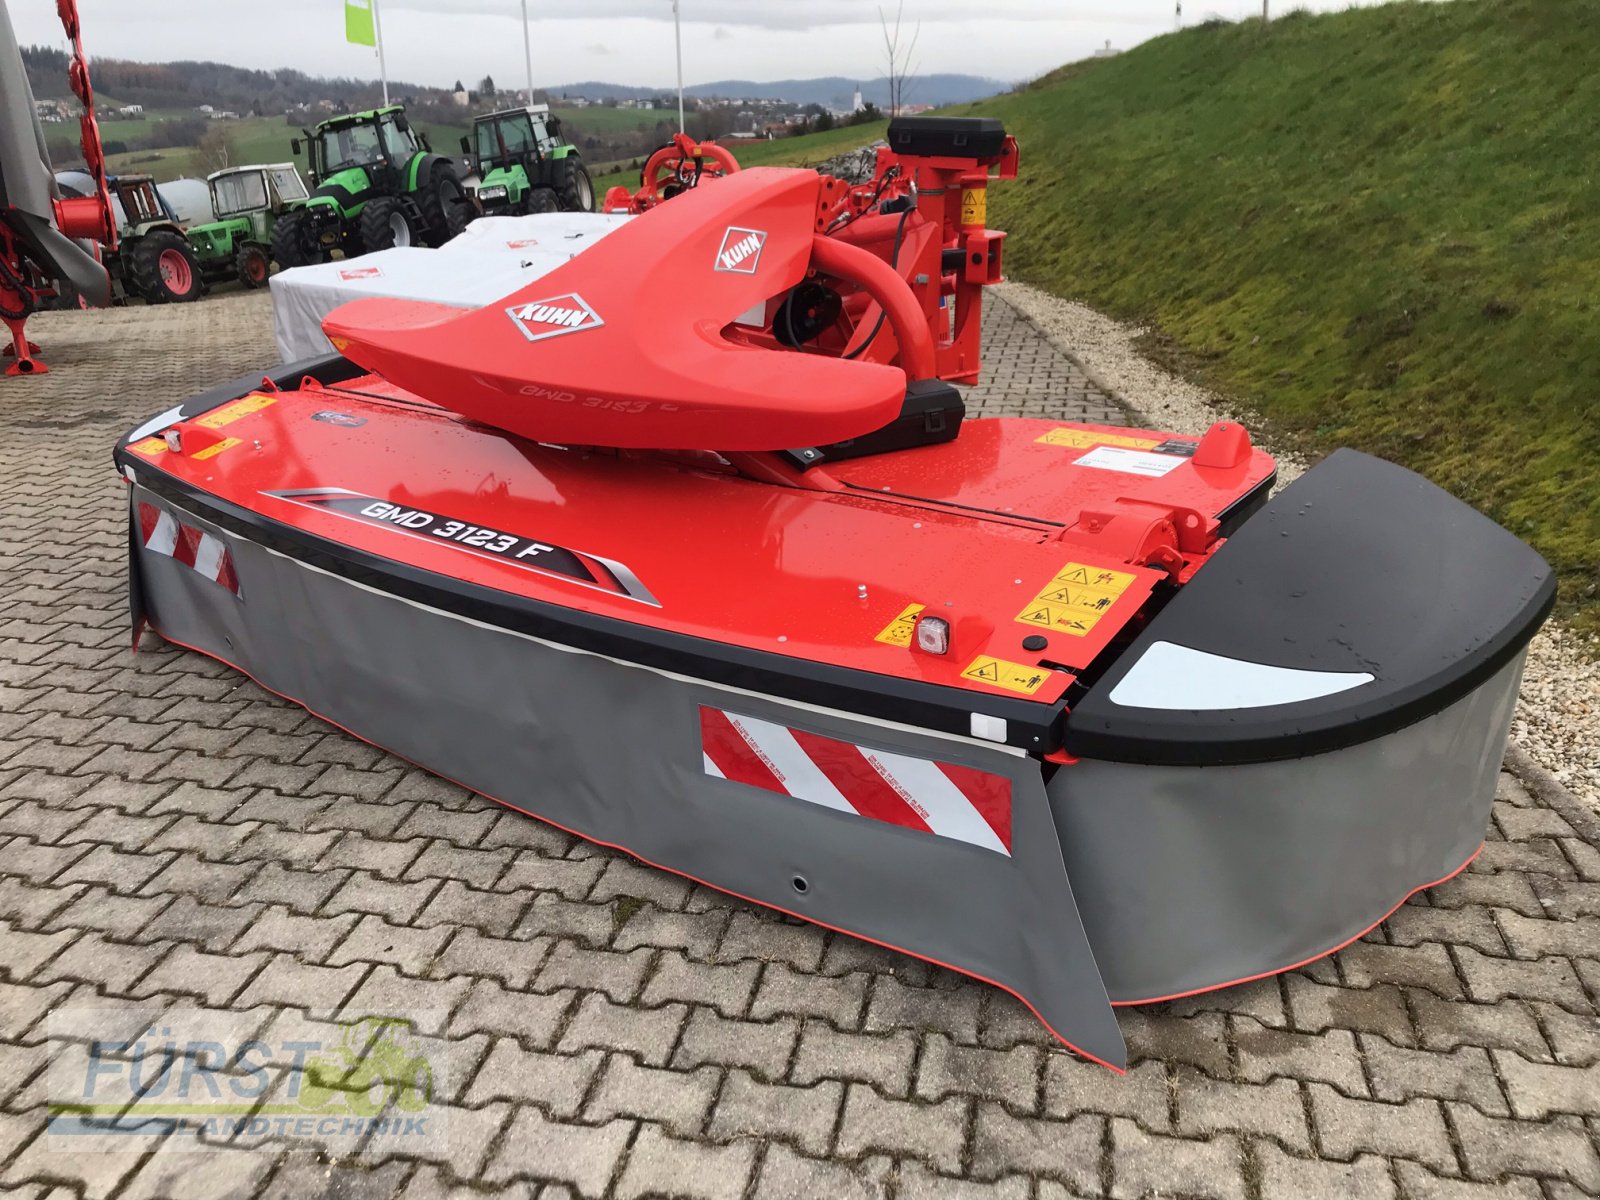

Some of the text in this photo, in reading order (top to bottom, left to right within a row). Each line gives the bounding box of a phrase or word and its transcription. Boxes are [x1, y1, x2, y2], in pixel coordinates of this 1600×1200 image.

[720, 232, 761, 269] KUHN
[517, 303, 589, 327] KUHN
[360, 501, 554, 559] GMD 3123 F
